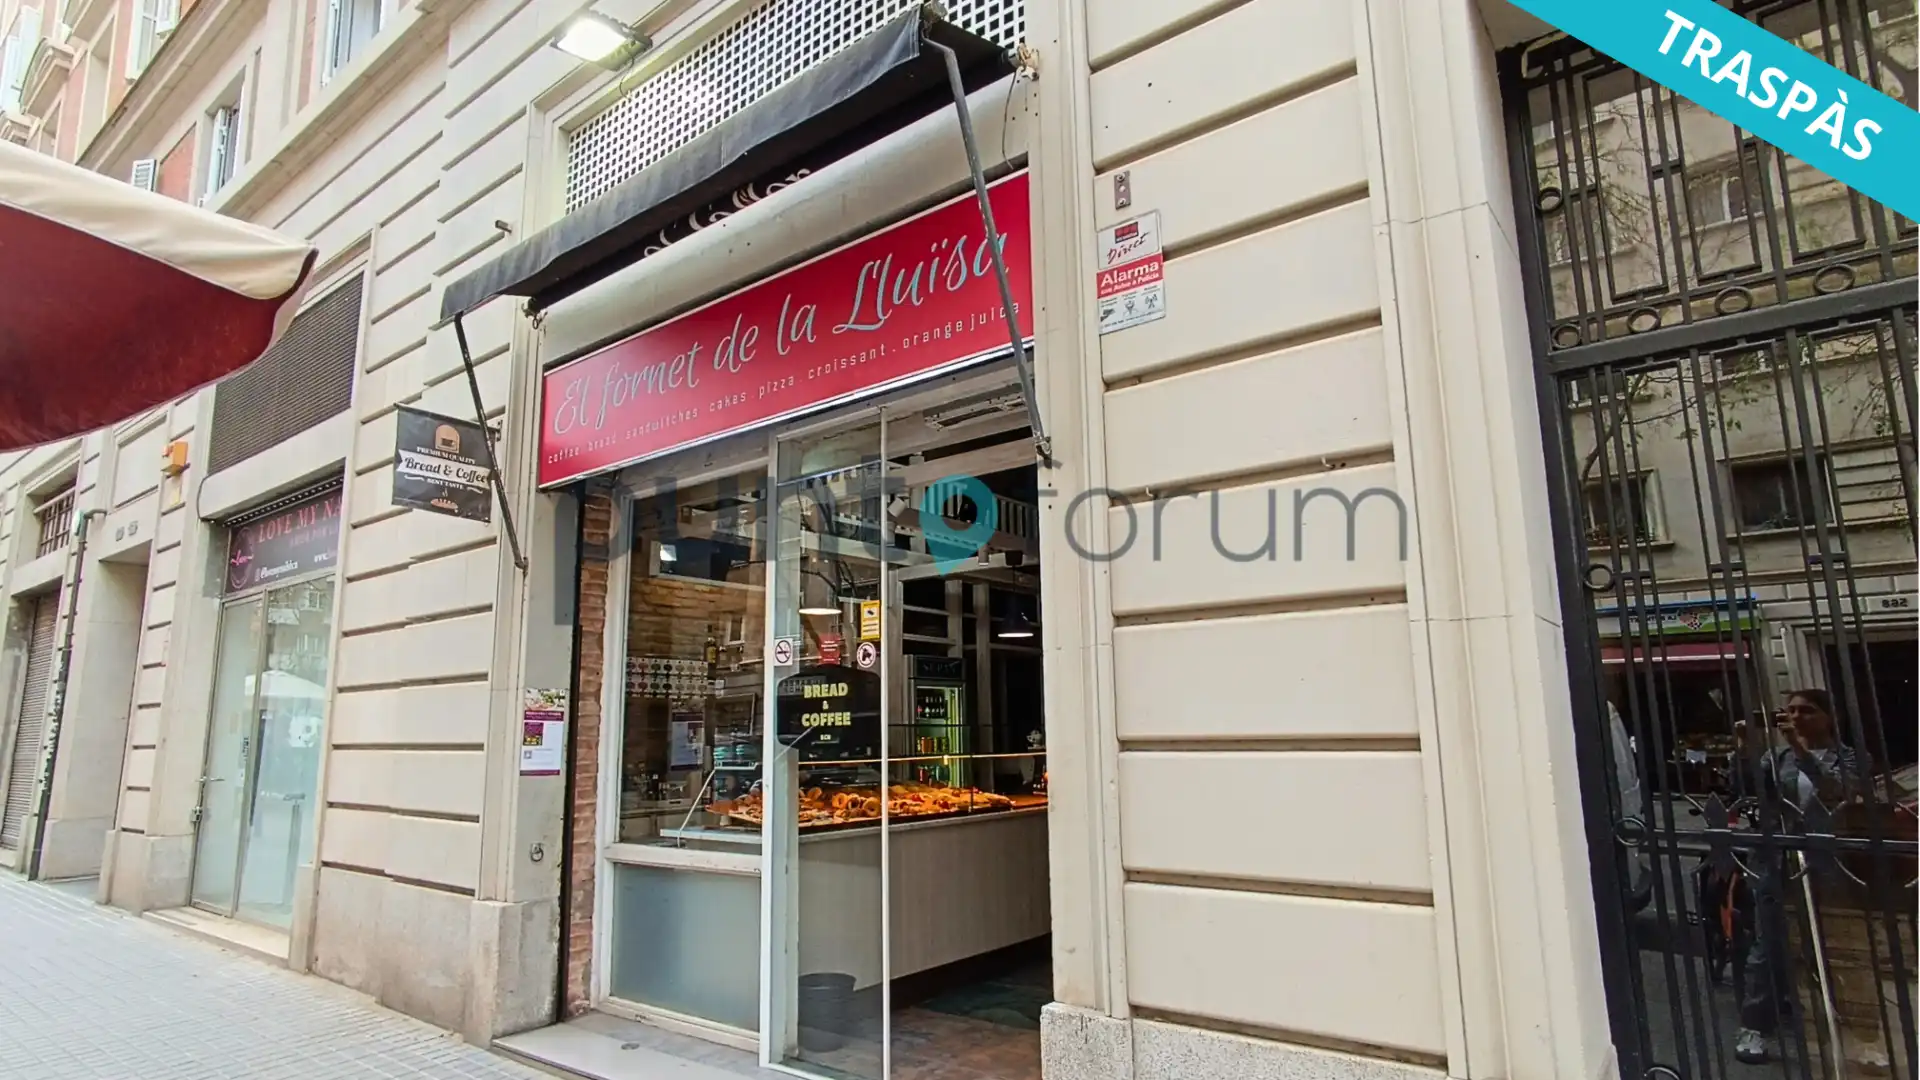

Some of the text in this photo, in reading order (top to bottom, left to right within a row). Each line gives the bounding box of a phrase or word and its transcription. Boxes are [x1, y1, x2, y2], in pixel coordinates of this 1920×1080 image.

[1107, 232, 1150, 264] Direct
[1101, 260, 1159, 288] Alarma
[554, 375, 592, 434] El
[595, 341, 703, 430] fornet
[713, 313, 759, 373] de
[777, 294, 817, 356] la
[548, 447, 579, 464] coffee
[709, 391, 747, 412] cakes
[759, 374, 795, 399] pizza
[808, 343, 886, 380] croissant
[405, 457, 486, 484] Bread & Coffee
[258, 513, 293, 543] LOVE
[296, 503, 320, 529] MY
[804, 682, 849, 699] BREAD
[801, 711, 852, 727] COFFEE
[822, 700, 829, 710] &
